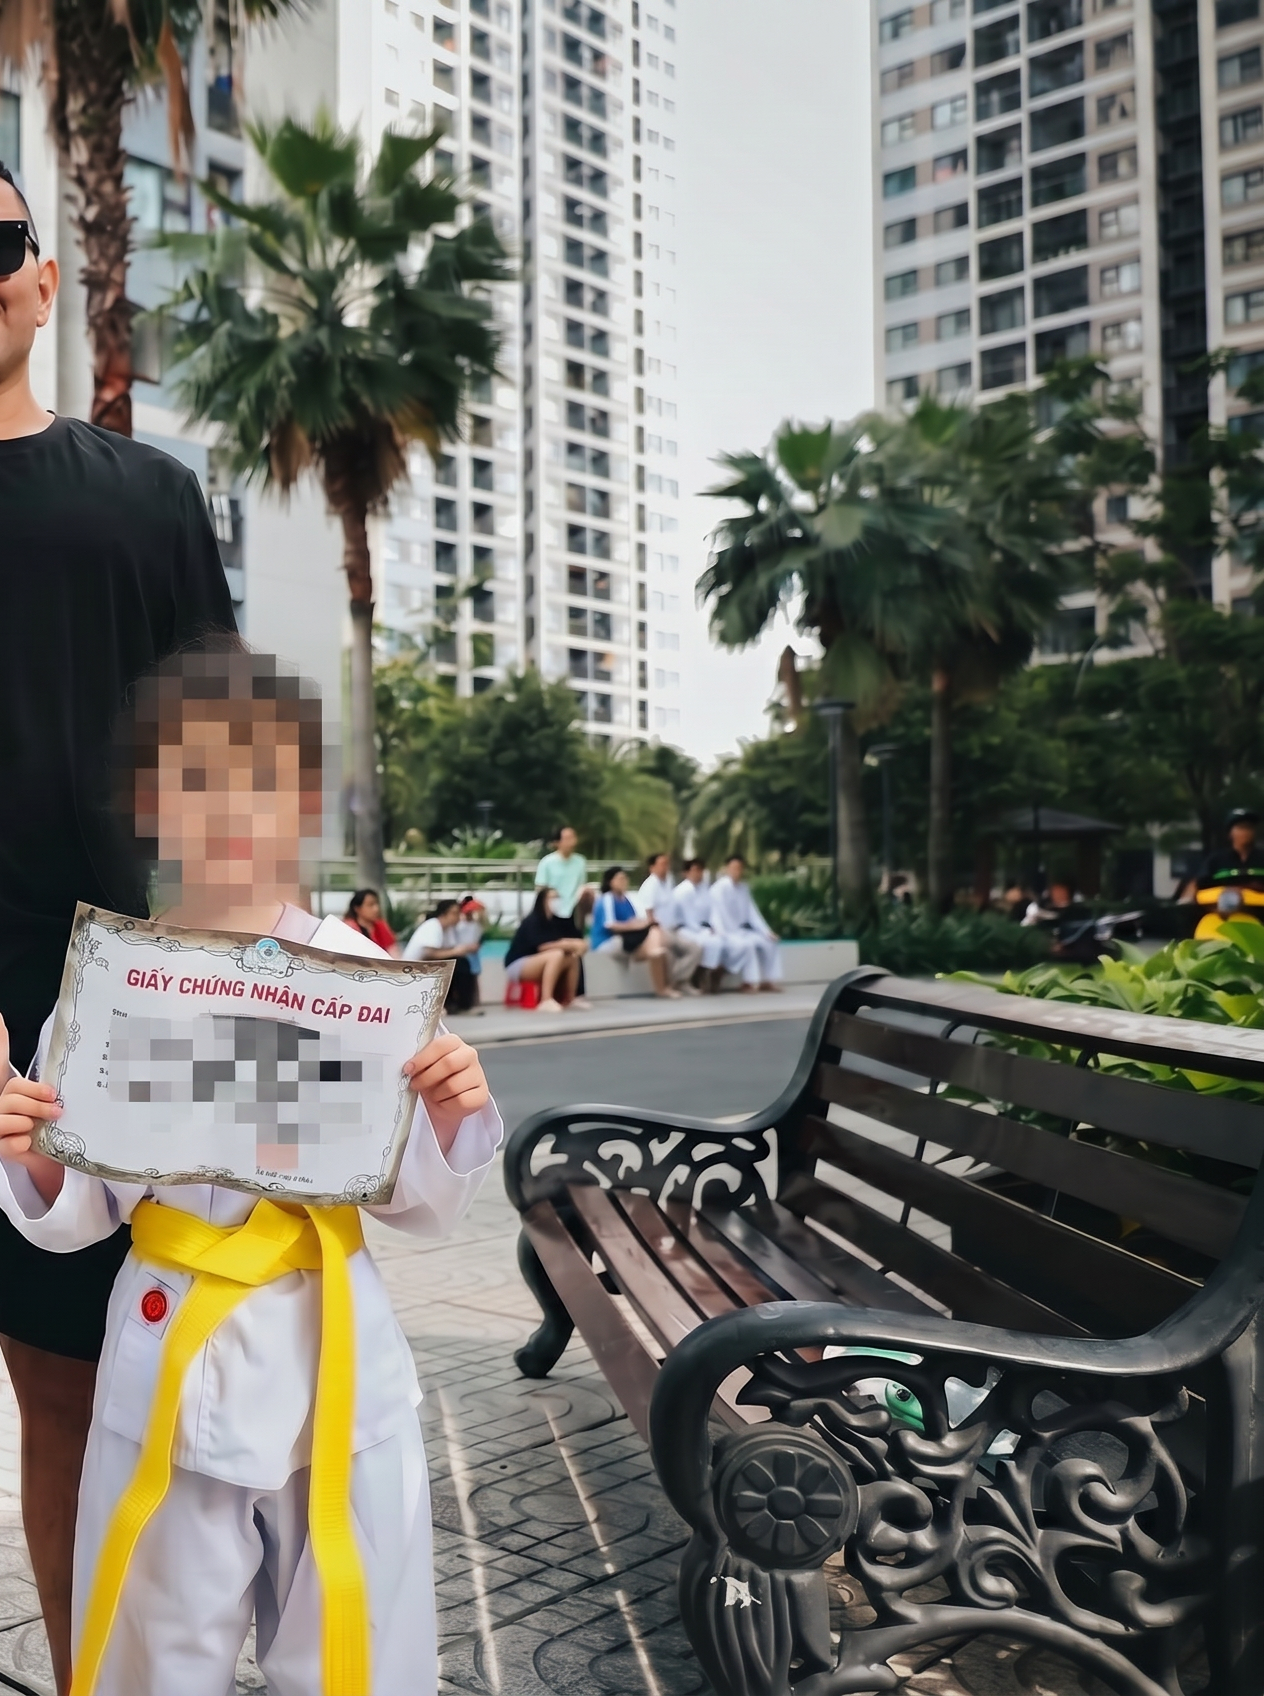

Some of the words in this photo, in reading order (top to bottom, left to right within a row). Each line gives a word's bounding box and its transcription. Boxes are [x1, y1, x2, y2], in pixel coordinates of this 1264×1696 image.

[127, 966, 174, 992] GIẤY
[179, 974, 246, 997] CHỨNG
[250, 982, 306, 1011] NHẬN
[311, 995, 353, 1020] CẤP
[357, 1005, 391, 1024] ĐAI
